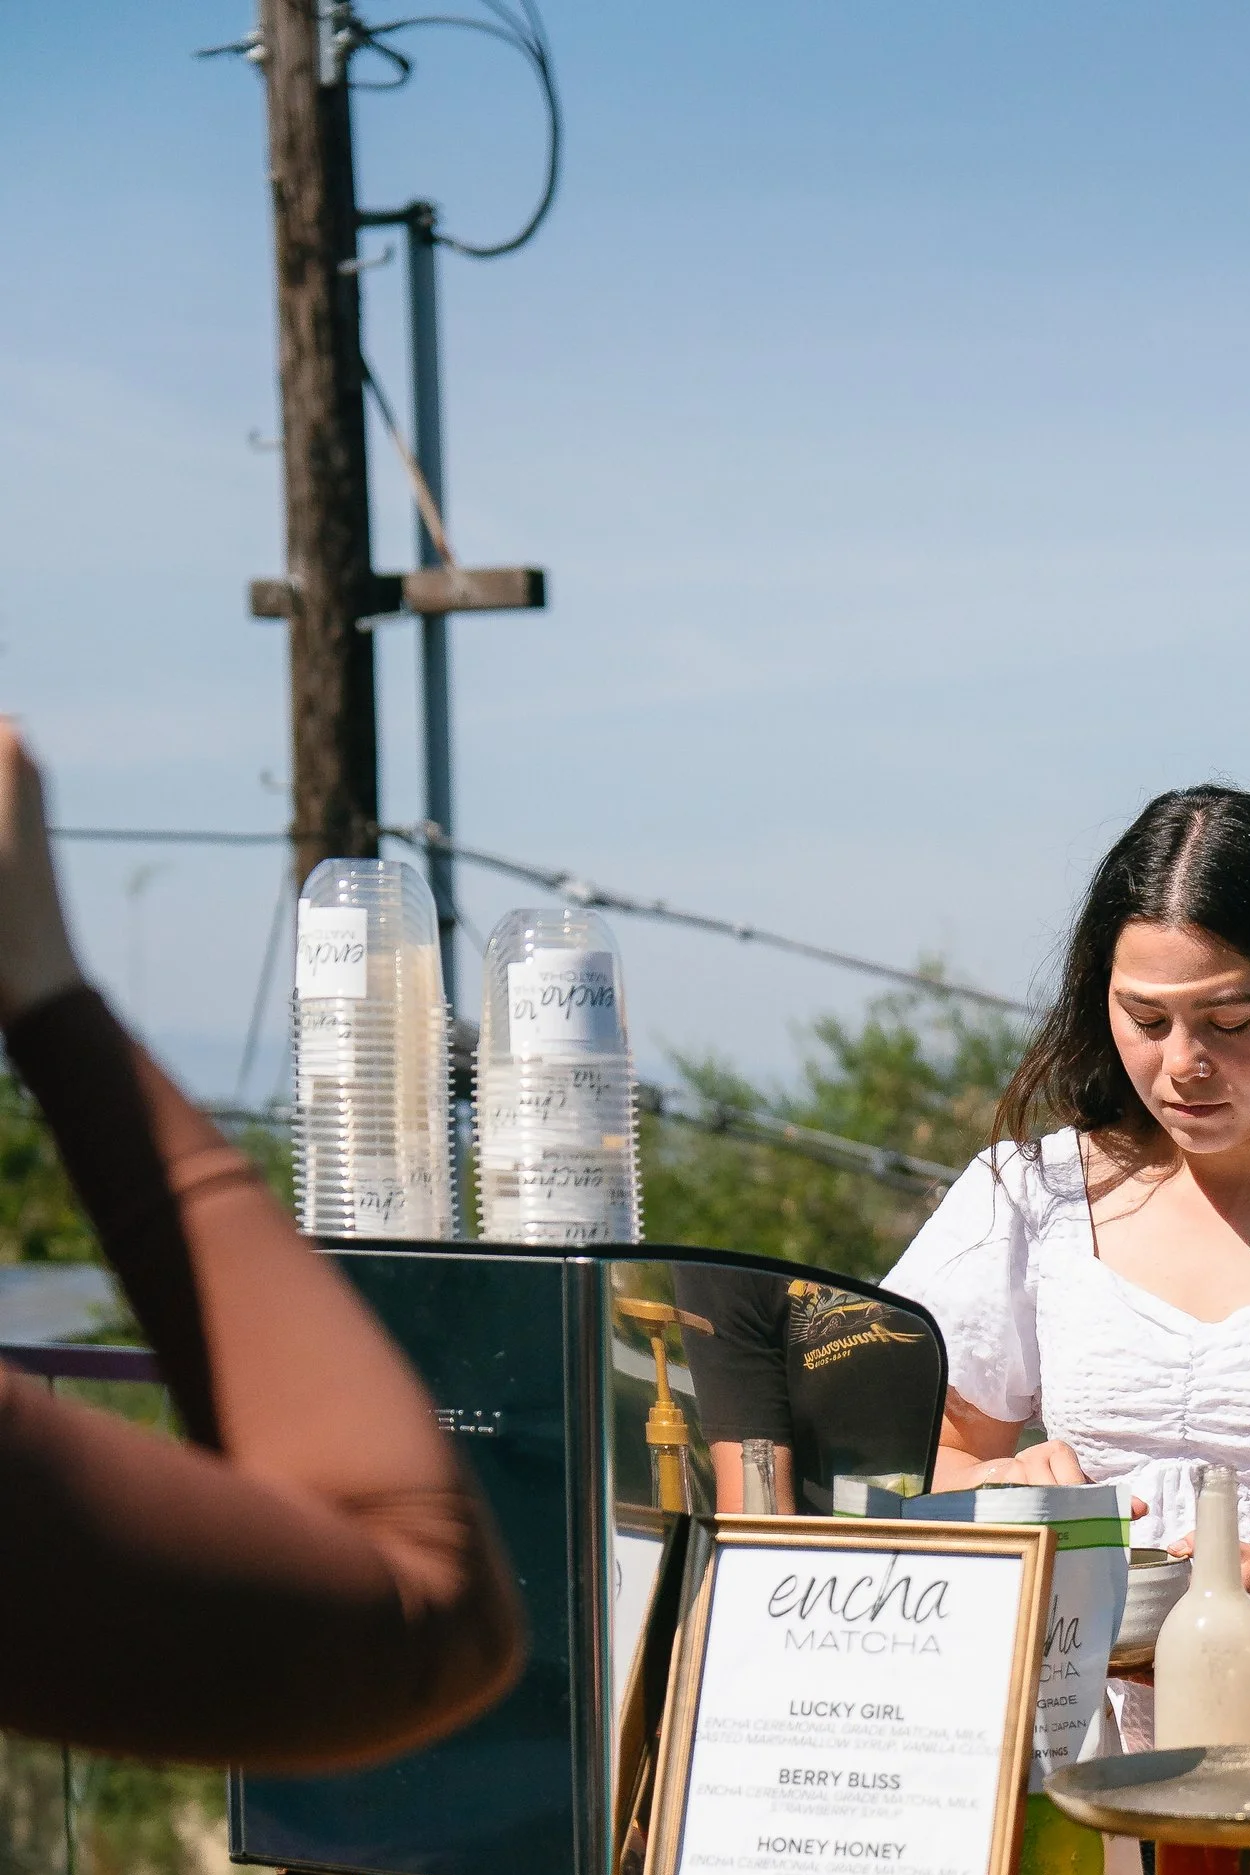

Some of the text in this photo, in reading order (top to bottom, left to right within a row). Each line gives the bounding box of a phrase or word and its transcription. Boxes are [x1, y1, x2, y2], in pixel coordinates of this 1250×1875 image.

[538, 985, 615, 1021] encha
[767, 1552, 950, 1623] encha
[783, 1627, 943, 1657] MATCHA
[789, 1700, 905, 1721] LUCKY GIRL
[1036, 1694, 1078, 1709] GRADE
[1051, 1718, 1087, 1732] JAPAN
[778, 1768, 902, 1791] BERRY BLISS
[757, 1836, 907, 1860] HONEY HONEY
